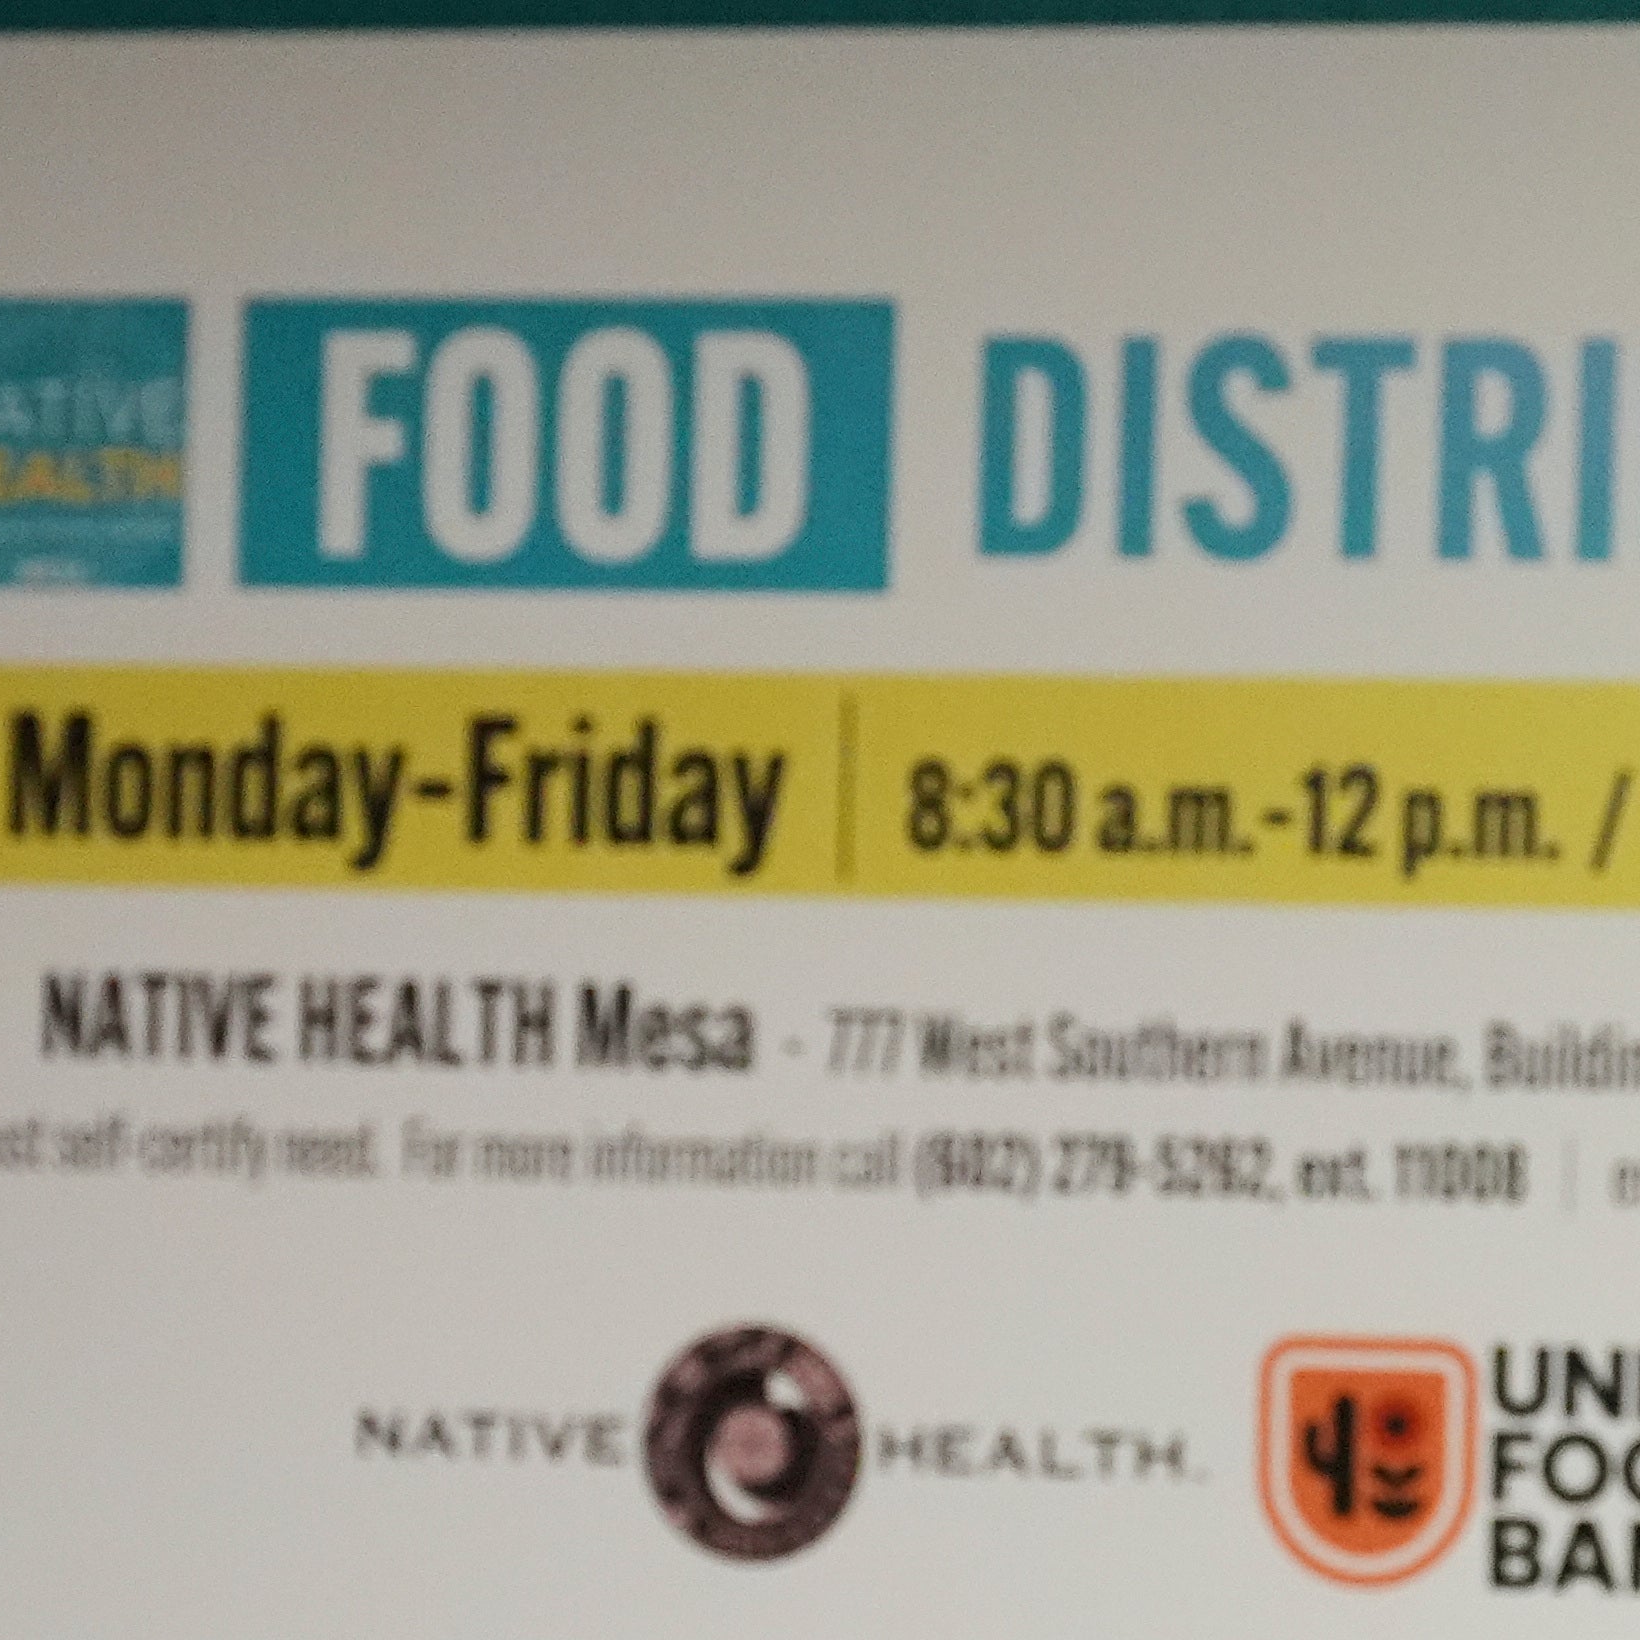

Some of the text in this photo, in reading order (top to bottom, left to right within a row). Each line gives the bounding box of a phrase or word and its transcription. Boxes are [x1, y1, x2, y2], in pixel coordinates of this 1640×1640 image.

[317, 325, 812, 566] FOOD
[3, 705, 787, 879] Monday-Friday
[904, 755, 1077, 857] 8:30
[1096, 762, 1382, 861] a.m.-12
[1399, 787, 1561, 882] p.m.
[41, 971, 276, 1064] NATIVE
[298, 974, 556, 1068] HEALTH
[576, 980, 755, 1073] Mesa
[826, 1005, 901, 1074] 777
[916, 1015, 1034, 1077] West
[355, 1408, 623, 1466] NATIVE
